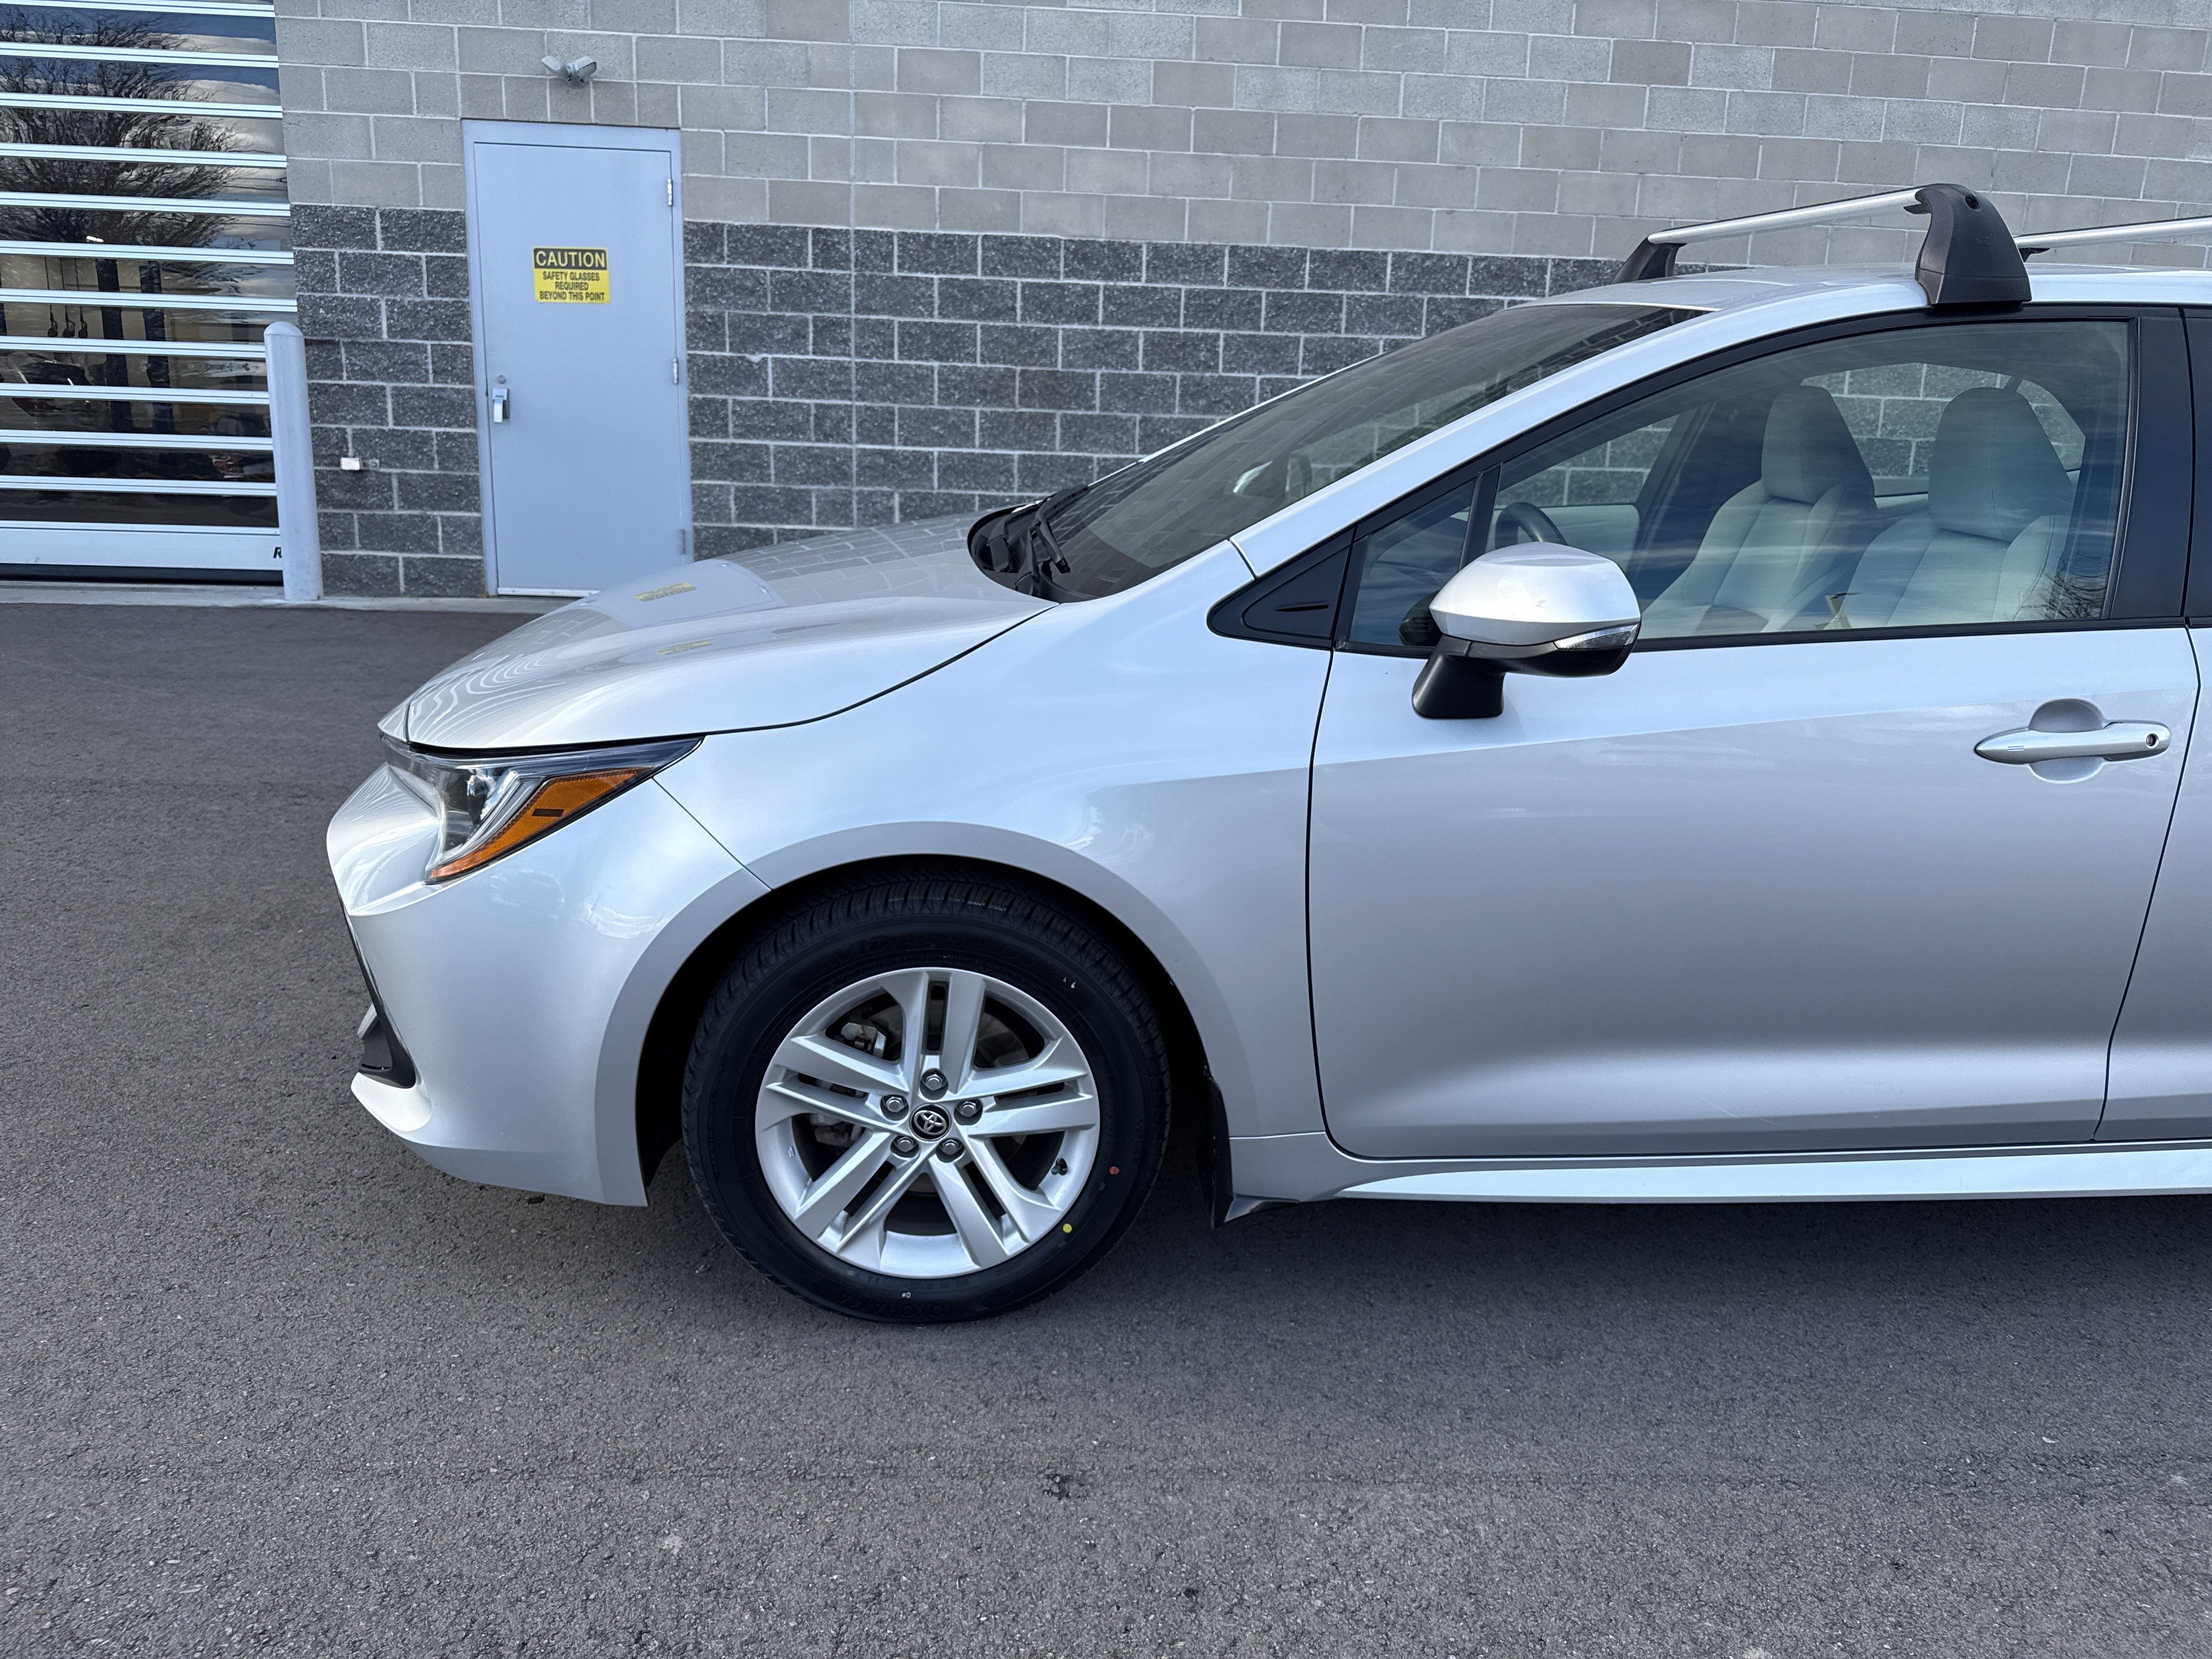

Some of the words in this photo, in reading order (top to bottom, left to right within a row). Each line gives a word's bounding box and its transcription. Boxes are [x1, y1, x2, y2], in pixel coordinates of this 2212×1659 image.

[535, 251, 605, 268] CAUTION
[543, 271, 568, 280] SAFETY
[569, 272, 600, 281] GLASSES
[555, 281, 589, 291] REQUIRED
[539, 291, 567, 300] BEYOND
[568, 291, 584, 301] THIS
[585, 292, 605, 301] POINT
[839, 1292, 958, 1318] YOKOHAMA
